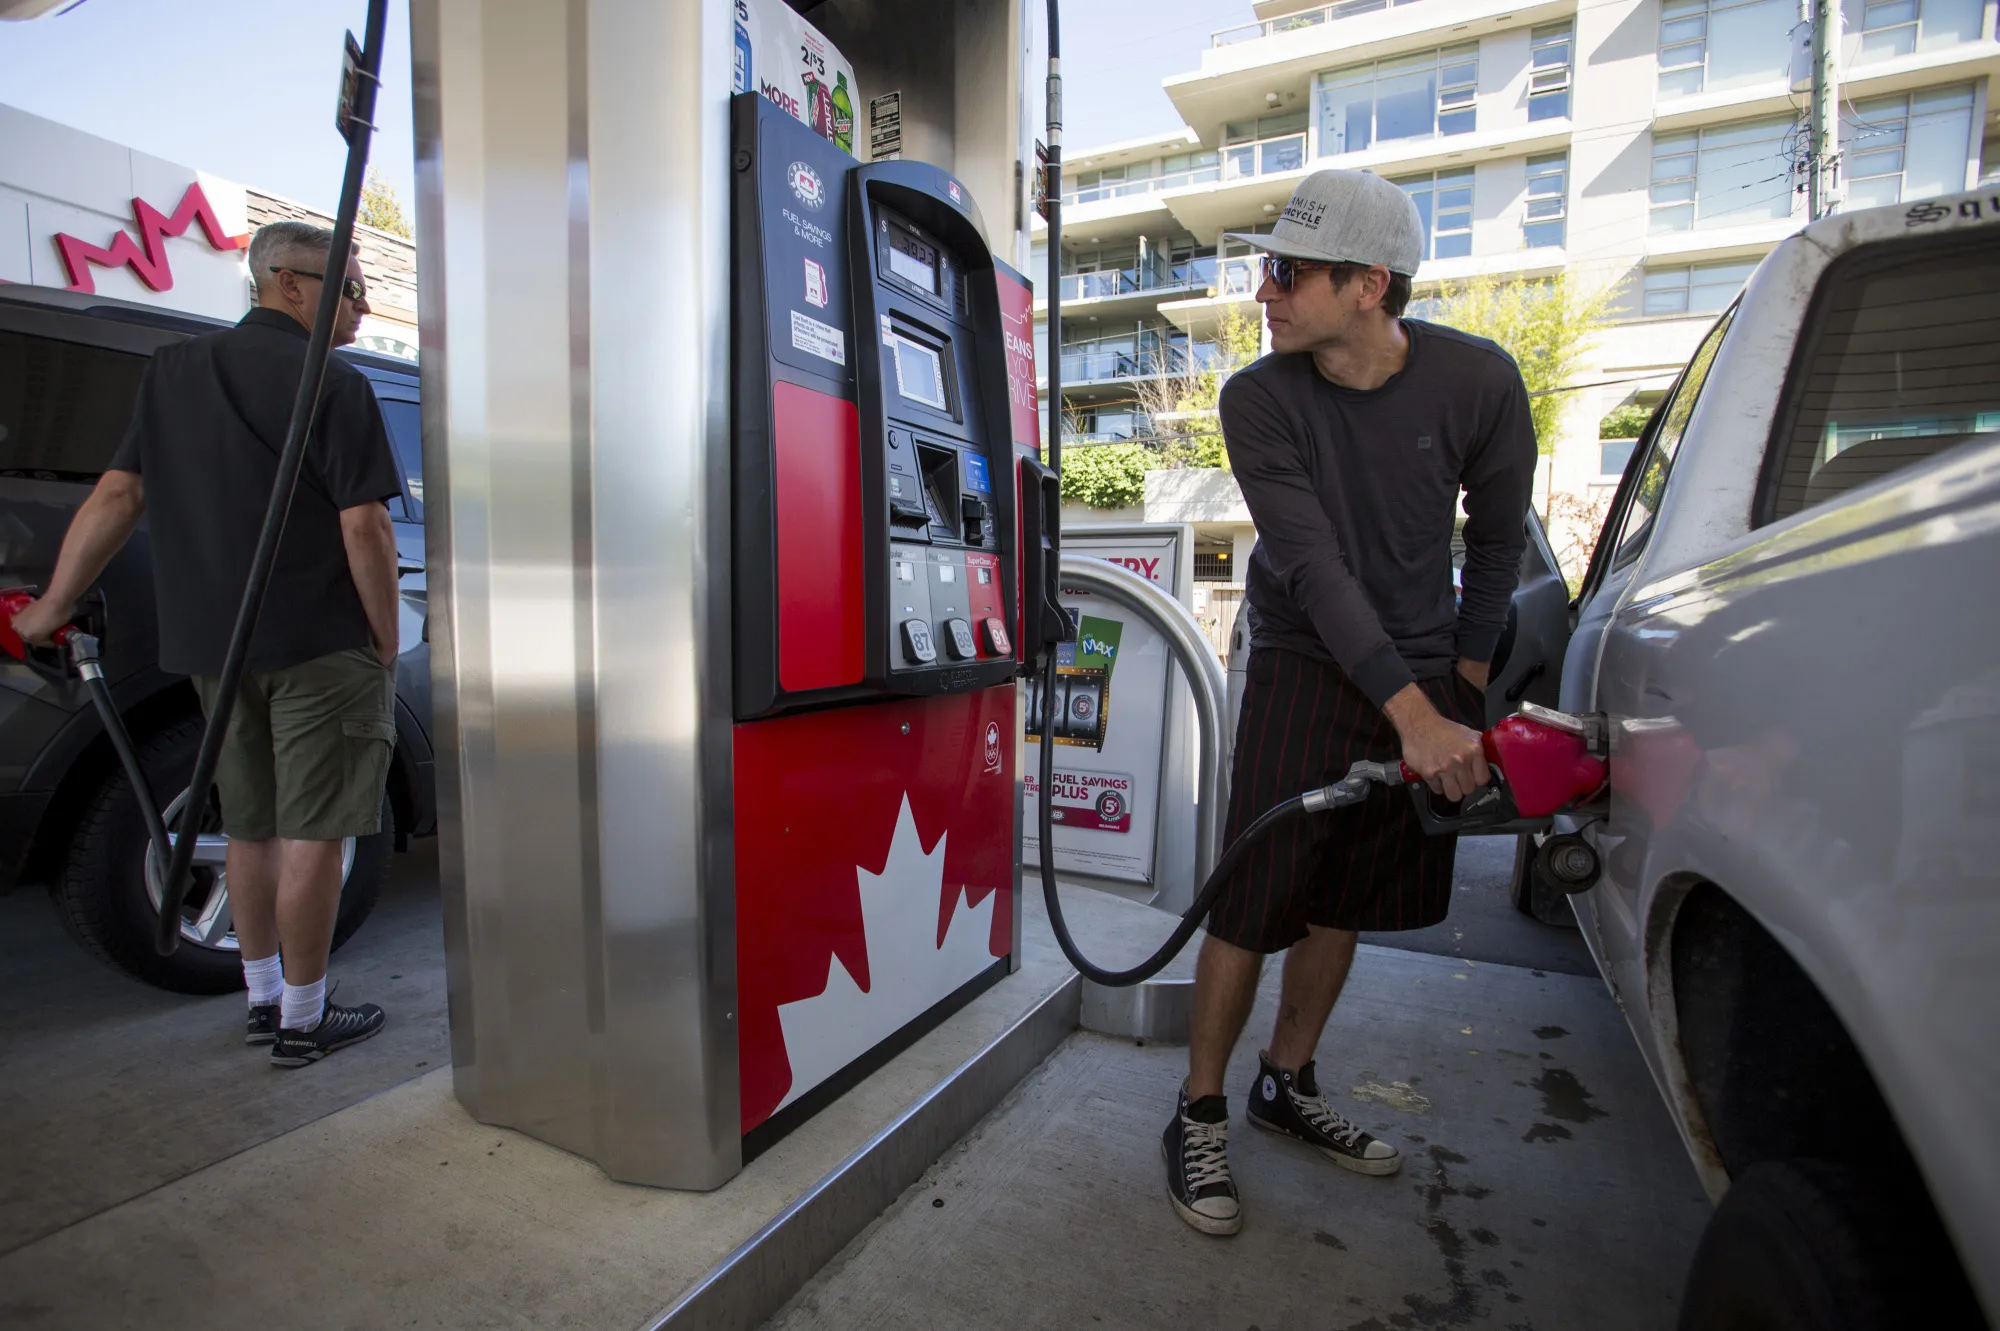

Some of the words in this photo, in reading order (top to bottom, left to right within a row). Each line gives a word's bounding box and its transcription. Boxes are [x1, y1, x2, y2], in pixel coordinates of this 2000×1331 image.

[760, 76, 800, 119] MORE
[792, 163, 821, 187] PETRO
[790, 181, 822, 208] POINTS
[782, 208, 801, 227] FUEL
[801, 218, 832, 243] SAVINGS
[881, 220, 887, 233] $
[794, 225, 801, 236] &
[801, 229, 824, 248] MORE
[941, 257, 947, 269] $
[1011, 354, 1035, 382] YOU
[913, 633, 930, 651] 87
[955, 631, 973, 649] 89
[992, 629, 1007, 645] 91
[1052, 773, 1079, 785] FUEL
[1081, 776, 1128, 790] SAVINGS
[1052, 785, 1089, 801] PLUS
[283, 1039, 317, 1047] MERRELL
